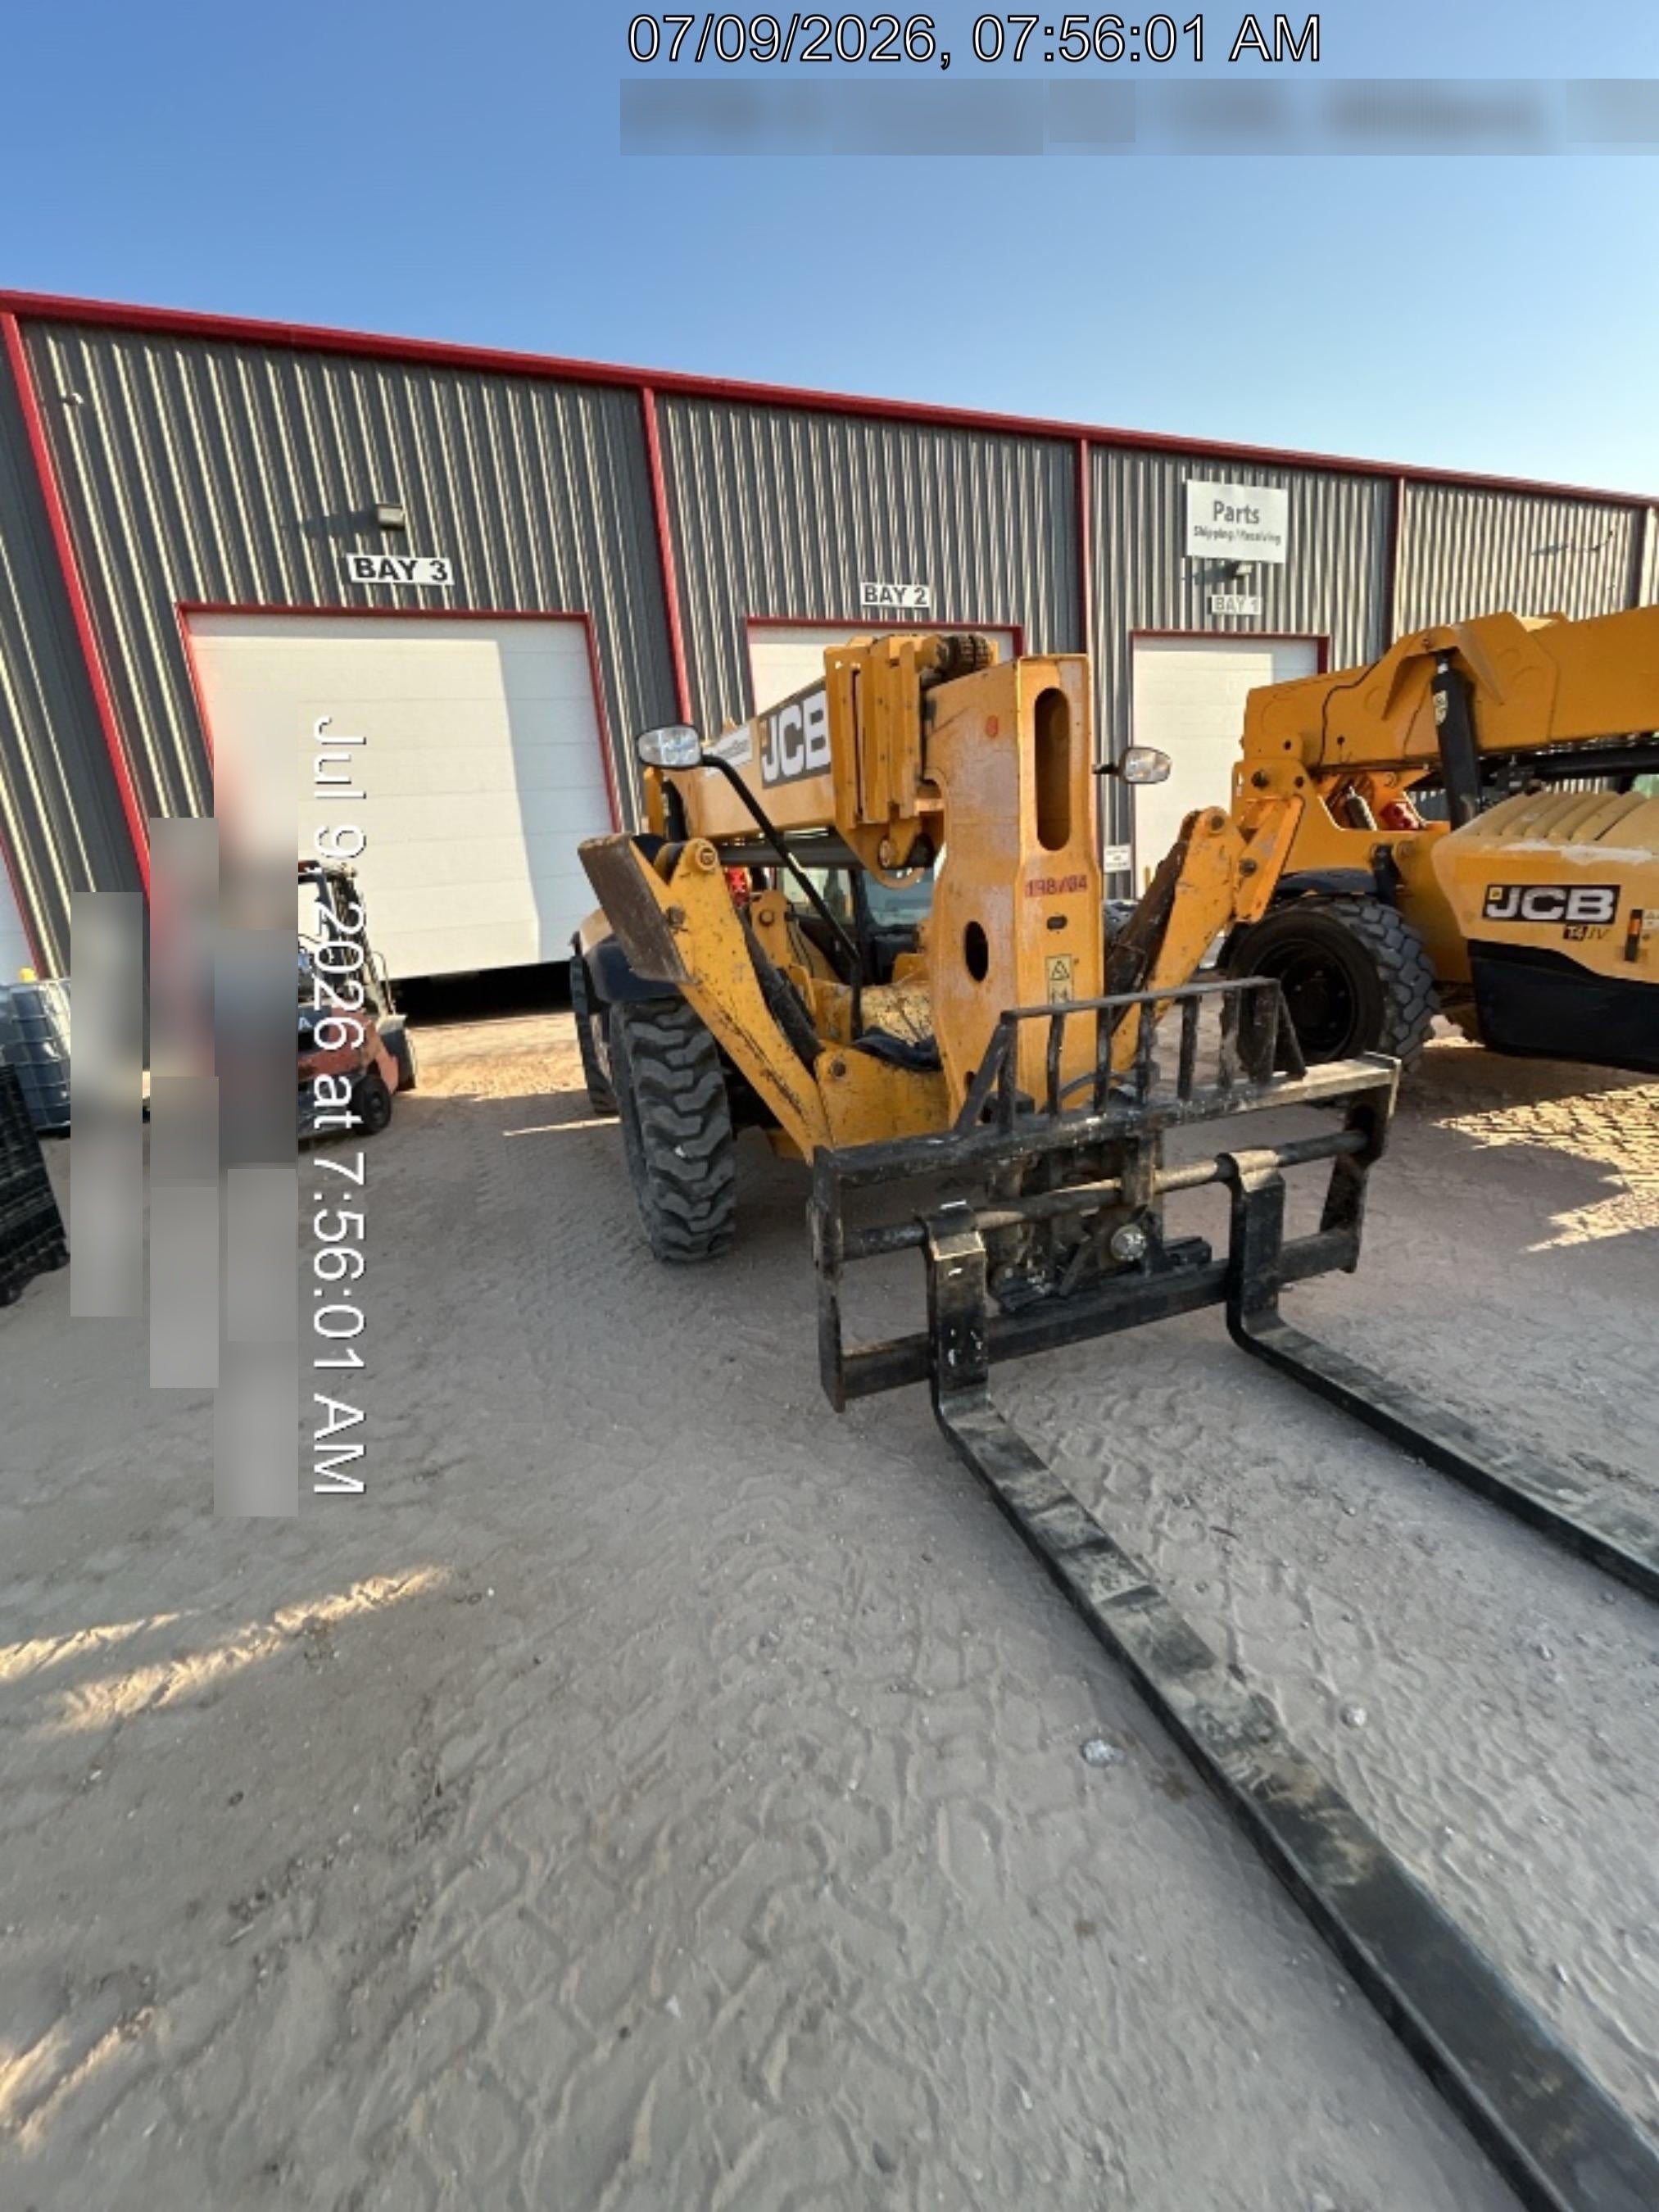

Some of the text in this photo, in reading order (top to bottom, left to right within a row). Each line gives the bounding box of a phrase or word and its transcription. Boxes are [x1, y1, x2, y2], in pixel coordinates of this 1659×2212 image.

[1213, 500, 1260, 524] Parts
[353, 557, 448, 582] BAY 3
[864, 584, 928, 605] BAY 2
[1215, 596, 1259, 613] BAY 1
[761, 690, 832, 782] JCB
[1485, 886, 1616, 922] JCB
